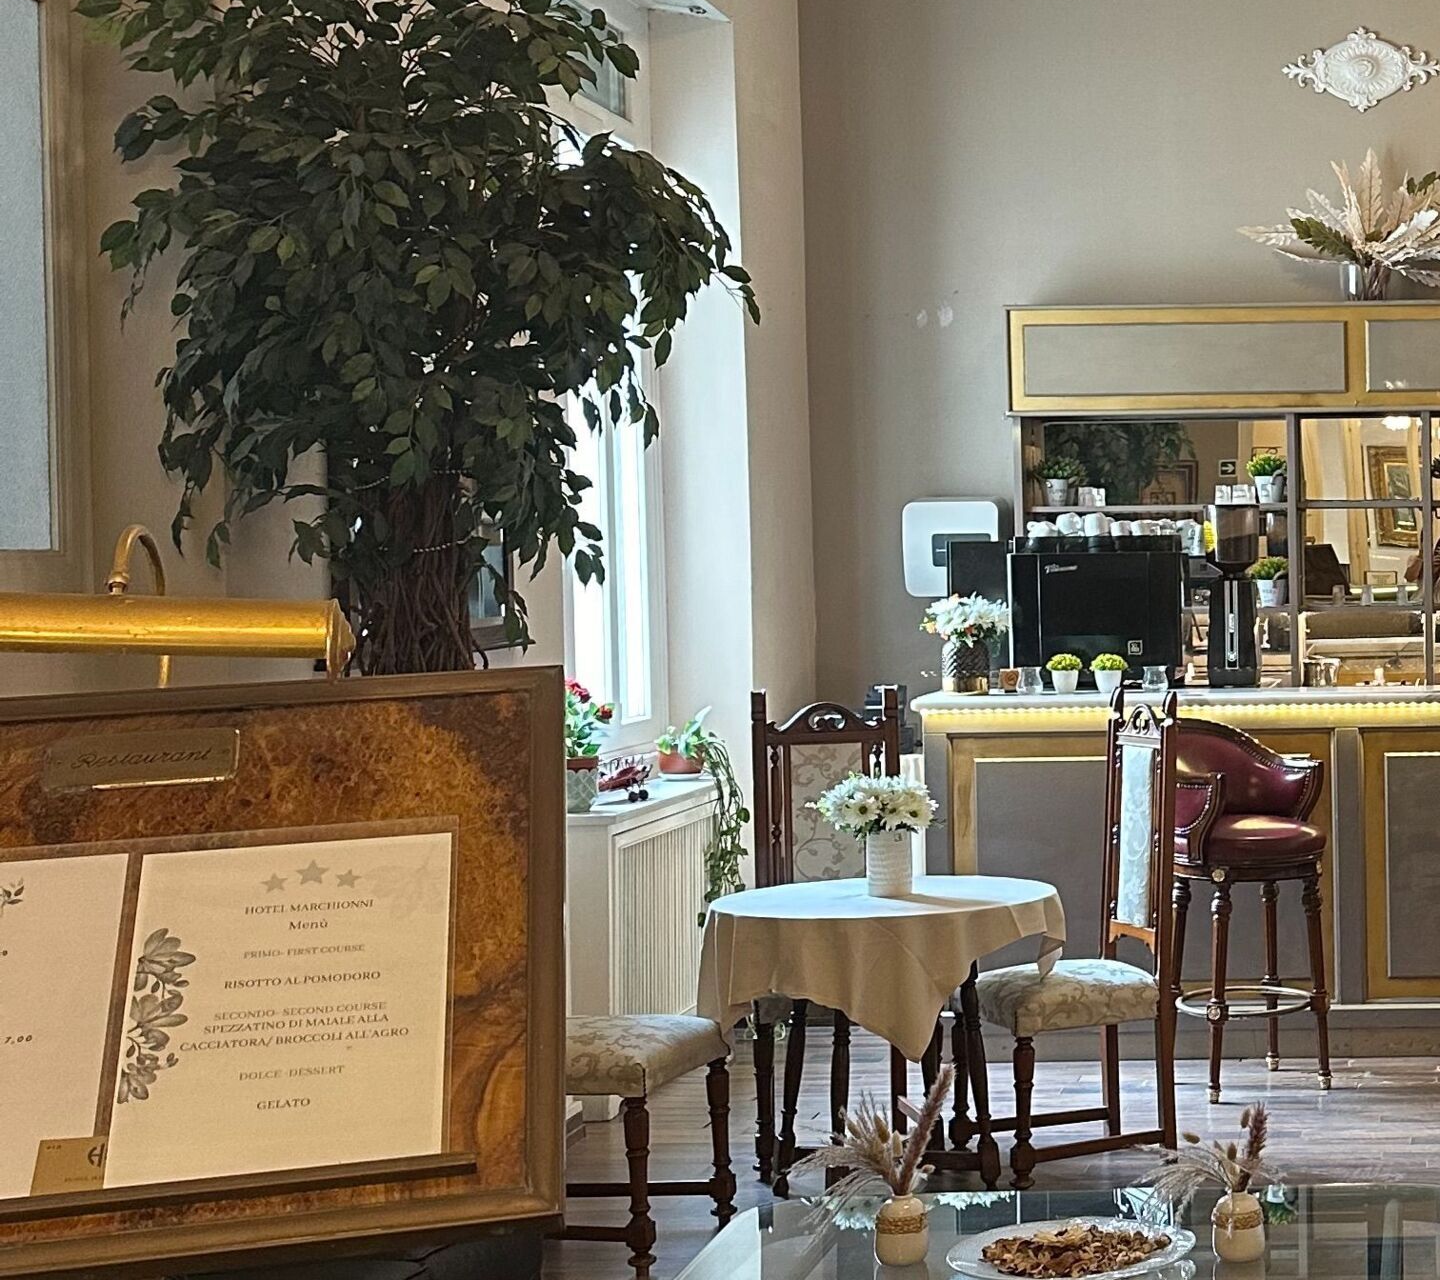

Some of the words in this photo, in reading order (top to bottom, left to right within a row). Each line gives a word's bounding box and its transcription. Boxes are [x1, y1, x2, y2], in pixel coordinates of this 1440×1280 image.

[245, 904, 285, 915] HOTEL
[290, 899, 374, 913] MARCHIONNI
[224, 976, 282, 989] RISOTTO
[284, 975, 301, 985] AL
[303, 970, 381, 985] POMODORO
[203, 1020, 286, 1035] SPEZZATINO
[288, 1019, 303, 1029] DI
[305, 1014, 356, 1028] MAIALE
[357, 1013, 389, 1024] ALLA
[275, 1031, 343, 1046] BROCCOLI
[238, 1069, 282, 1081] DOLCE
[288, 1064, 346, 1078] DESSERT
[256, 1097, 311, 1111] GELATO
